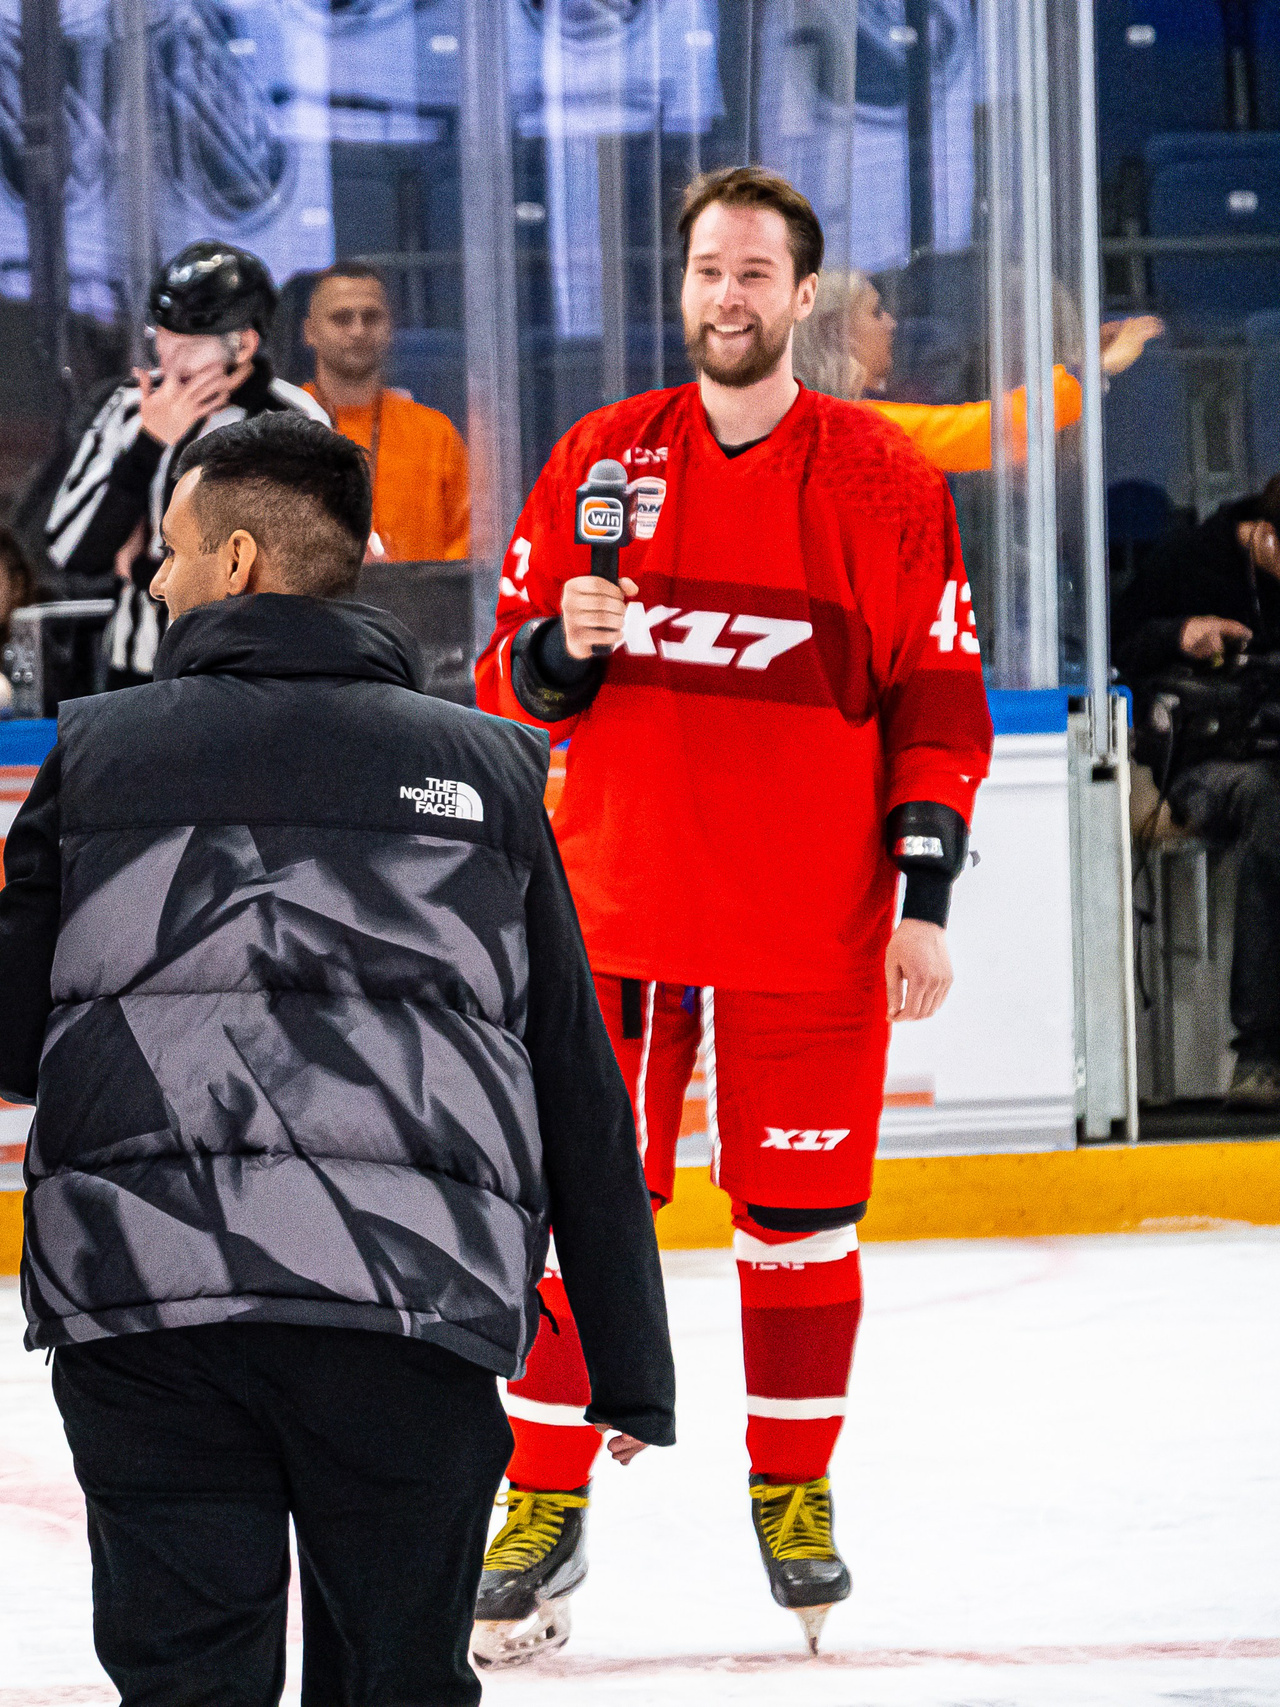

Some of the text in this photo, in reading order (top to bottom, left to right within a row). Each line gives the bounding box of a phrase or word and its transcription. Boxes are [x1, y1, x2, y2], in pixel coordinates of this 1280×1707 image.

[591, 512, 620, 527] Win
[612, 601, 814, 671] X17
[425, 777, 458, 793] THE
[400, 786, 457, 805] NORTH
[415, 800, 457, 817] FACE
[760, 1127, 851, 1152] X17
